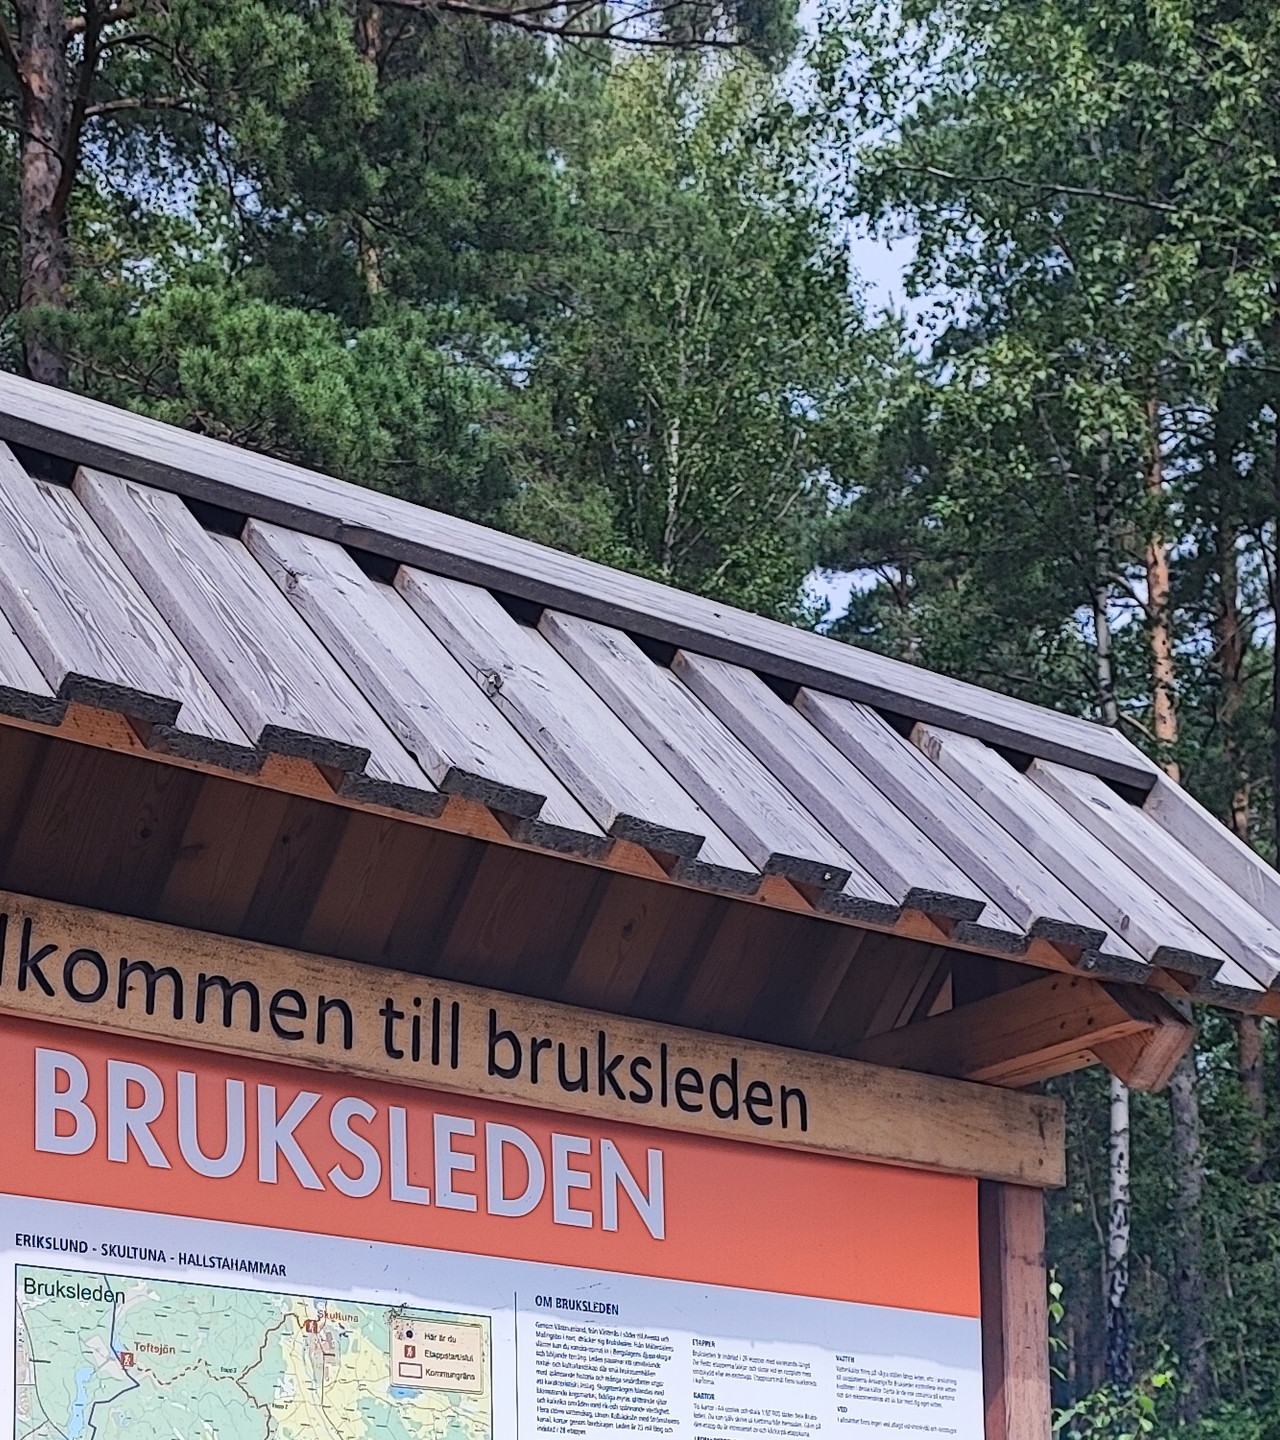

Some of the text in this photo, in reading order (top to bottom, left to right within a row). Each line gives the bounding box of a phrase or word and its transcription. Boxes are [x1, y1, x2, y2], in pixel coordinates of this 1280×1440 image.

[381, 998, 461, 1070] till
[488, 1008, 809, 1131] bruksleden
[35, 1047, 666, 1240] BRUKSLEDEN
[15, 1232, 88, 1253] ERIKSLUND
[100, 1243, 166, 1263] SKULTUNA
[178, 1252, 286, 1277] HALLSTAHAMMAR
[24, 1278, 125, 1303] Bruksleden
[534, 1294, 618, 1315] OM BRUKSLEDEN
